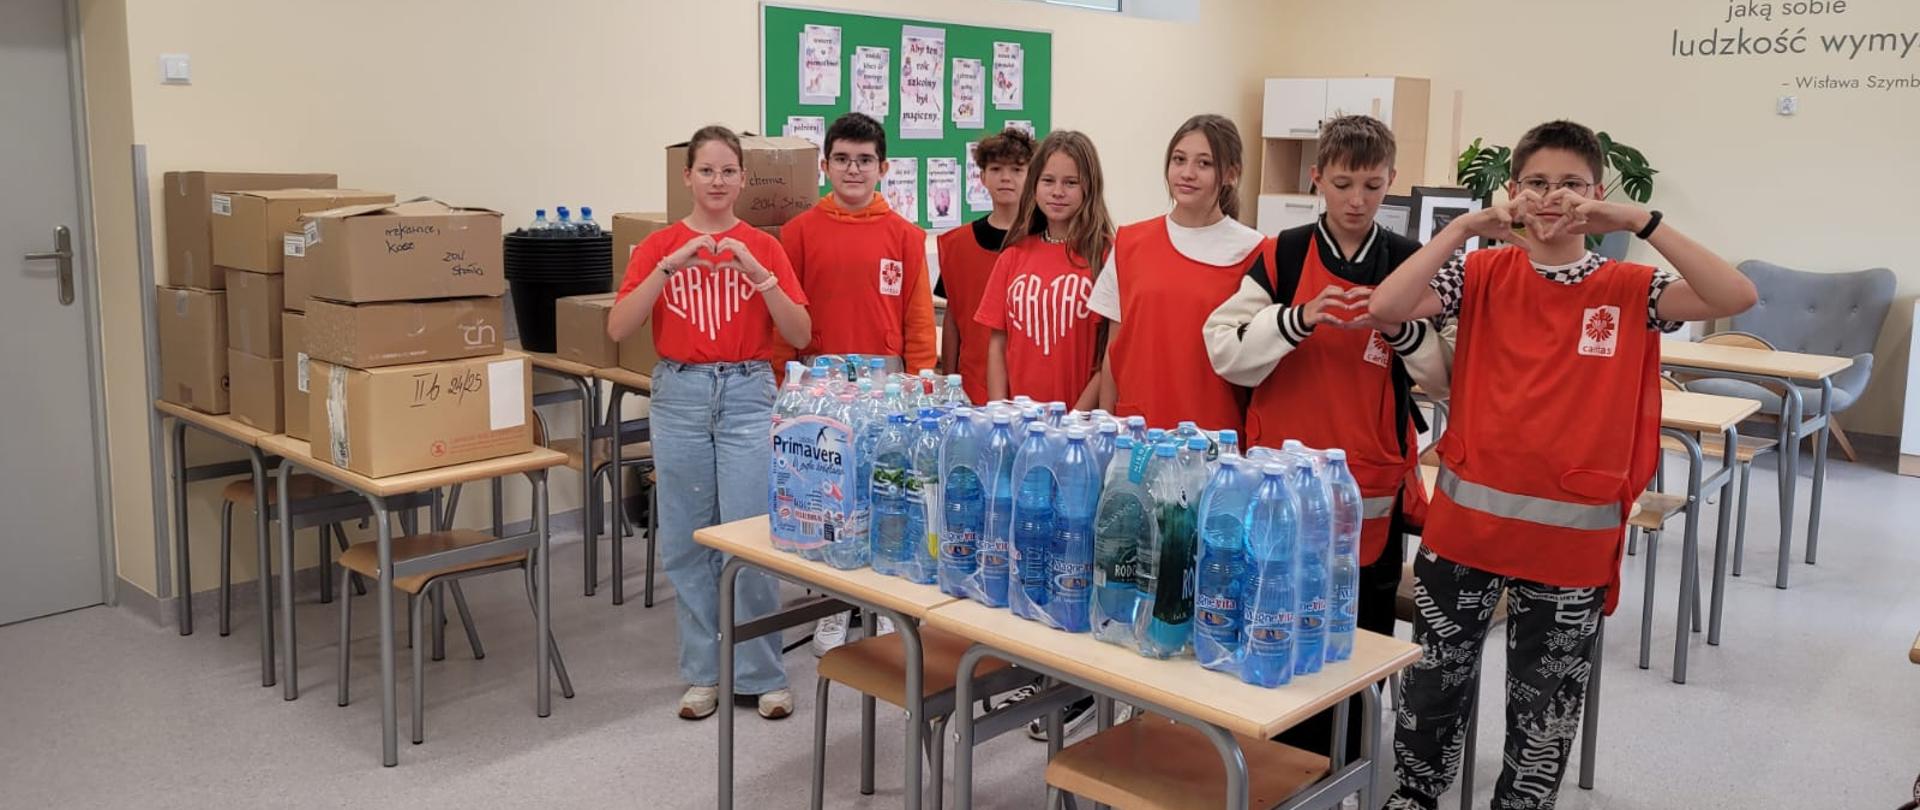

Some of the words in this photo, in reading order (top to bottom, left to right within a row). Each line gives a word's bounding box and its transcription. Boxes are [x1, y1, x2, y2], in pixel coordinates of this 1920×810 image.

[1672, 27, 1807, 56] ludzkość
[1820, 31, 1920, 60] wymy
[907, 76, 937, 89] szkolny
[1795, 75, 1860, 89] Wisława
[773, 434, 842, 466] Primavera
[1413, 576, 1463, 639] AROUND
[1456, 588, 1483, 611] THE
